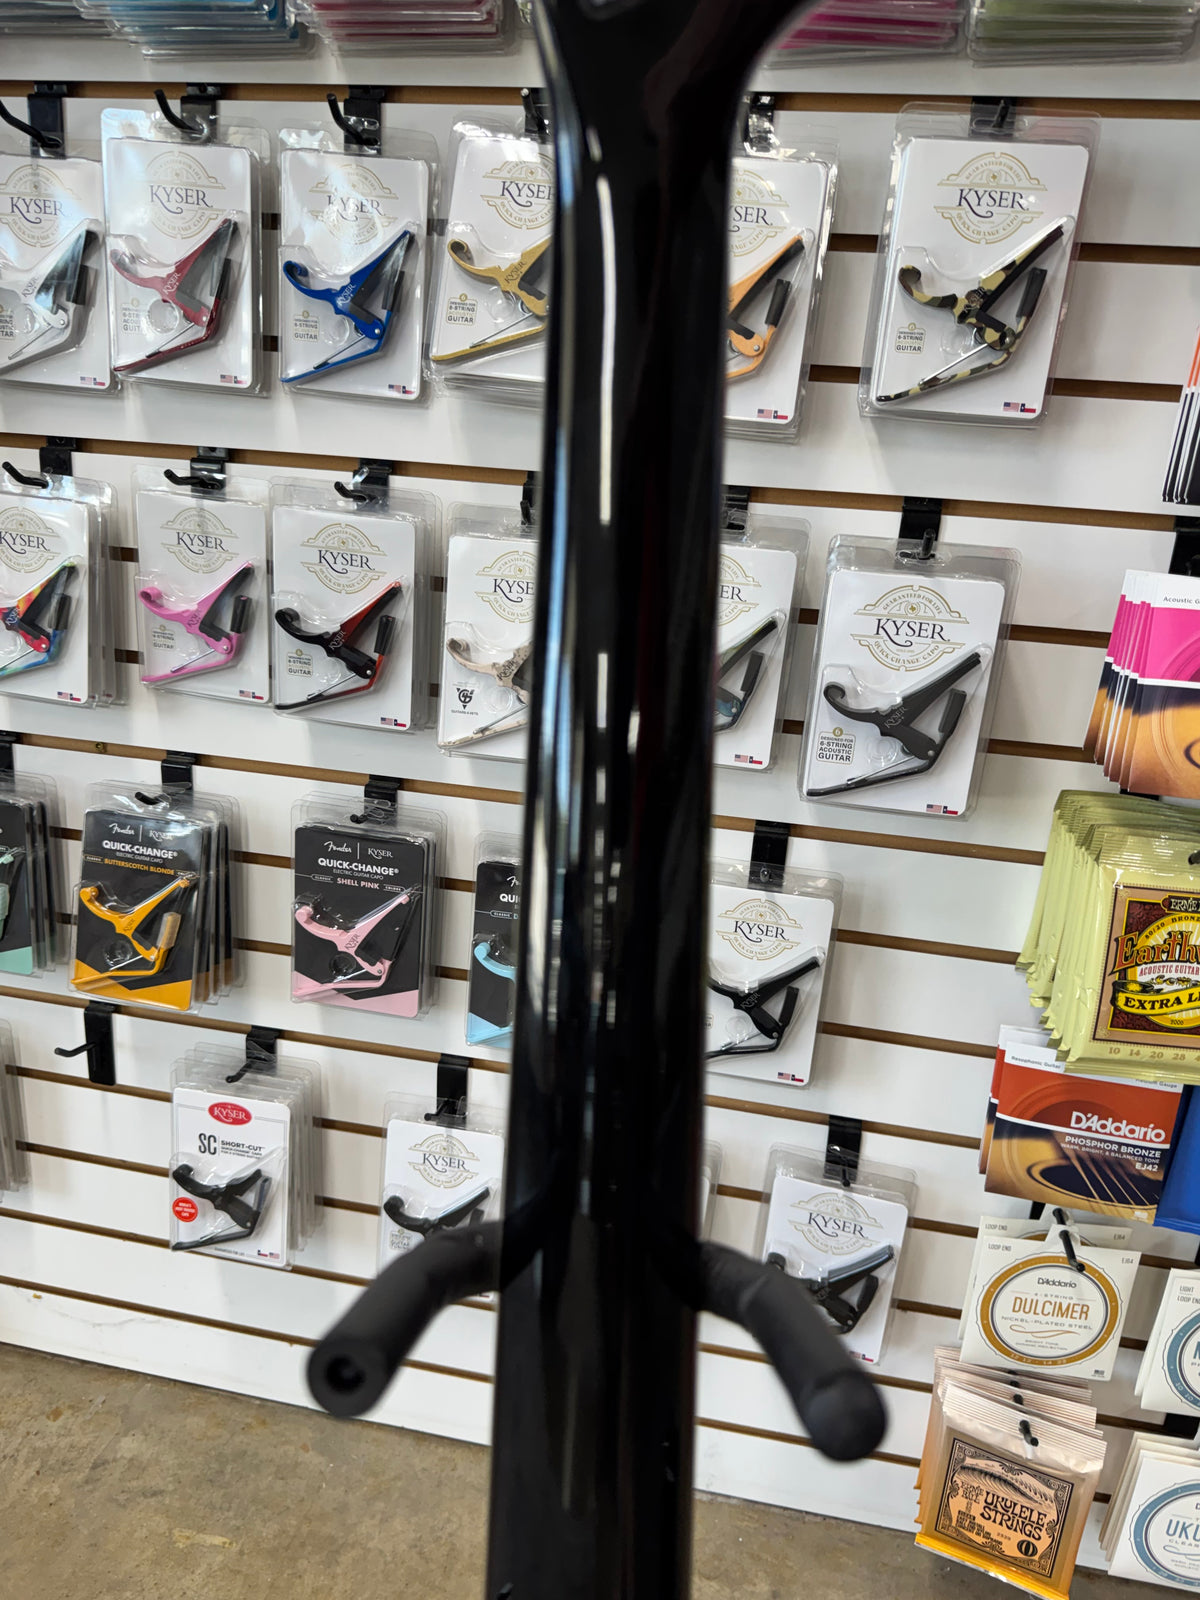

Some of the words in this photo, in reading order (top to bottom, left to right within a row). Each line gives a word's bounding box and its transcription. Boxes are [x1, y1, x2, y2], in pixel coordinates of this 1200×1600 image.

[149, 185, 212, 215] KYSER
[956, 188, 1028, 219] KYSER
[9, 196, 67, 225] KYSER
[728, 205, 771, 233] SER
[447, 315, 474, 324] GUITAR
[896, 344, 922, 352] GUITAR
[0, 530, 49, 555] KYSER
[176, 531, 228, 556] KYSER
[318, 549, 374, 575] KYSER
[493, 578, 535, 603] KYSE
[1163, 596, 1193, 604] Acoustic
[873, 618, 948, 648] KYSER
[922, 645, 940, 660] CAPO
[819, 740, 853, 749] 6-STRING
[819, 746, 852, 755] ACOUSTIC
[818, 752, 851, 762] GUITAR
[109, 823, 135, 835] Fender
[323, 841, 352, 853] Fender
[368, 847, 393, 859] KYSER
[104, 858, 149, 872] BUTTERSCOTCH
[149, 865, 175, 875] BLONDE
[333, 868, 353, 876] ELECTRIC
[353, 871, 370, 879] GUITAR
[337, 877, 359, 887] SHELL
[360, 881, 380, 890] PINK
[733, 920, 788, 943] KYSER
[1114, 930, 1200, 970] Earth
[1138, 964, 1173, 976] ACOUSTIC
[1123, 995, 1183, 1011] EXTRA
[1109, 1046, 1121, 1055] 10
[1128, 1048, 1141, 1057] 14
[1150, 1050, 1164, 1059] 20
[1172, 1053, 1186, 1061] 28
[1159, 1081, 1178, 1089] Gauge
[213, 1106, 248, 1123] KYSER
[1070, 1110, 1166, 1143] D'Addario
[198, 1132, 217, 1156] SC
[1065, 1135, 1119, 1152] PHOSPHOR
[1121, 1145, 1162, 1158] BRONZE
[422, 1153, 468, 1174] KYSER
[1110, 1151, 1143, 1162] BALANCED
[1135, 1162, 1159, 1172] EJ42
[808, 1212, 866, 1238] KYSER
[1002, 1244, 1012, 1252] END
[1037, 1277, 1077, 1289] D'Addario
[1179, 1285, 1195, 1293] LIGHT
[1177, 1294, 1191, 1303] LOOP
[1012, 1296, 1090, 1321] DULCIMER
[984, 1490, 1048, 1528] UKULELE
